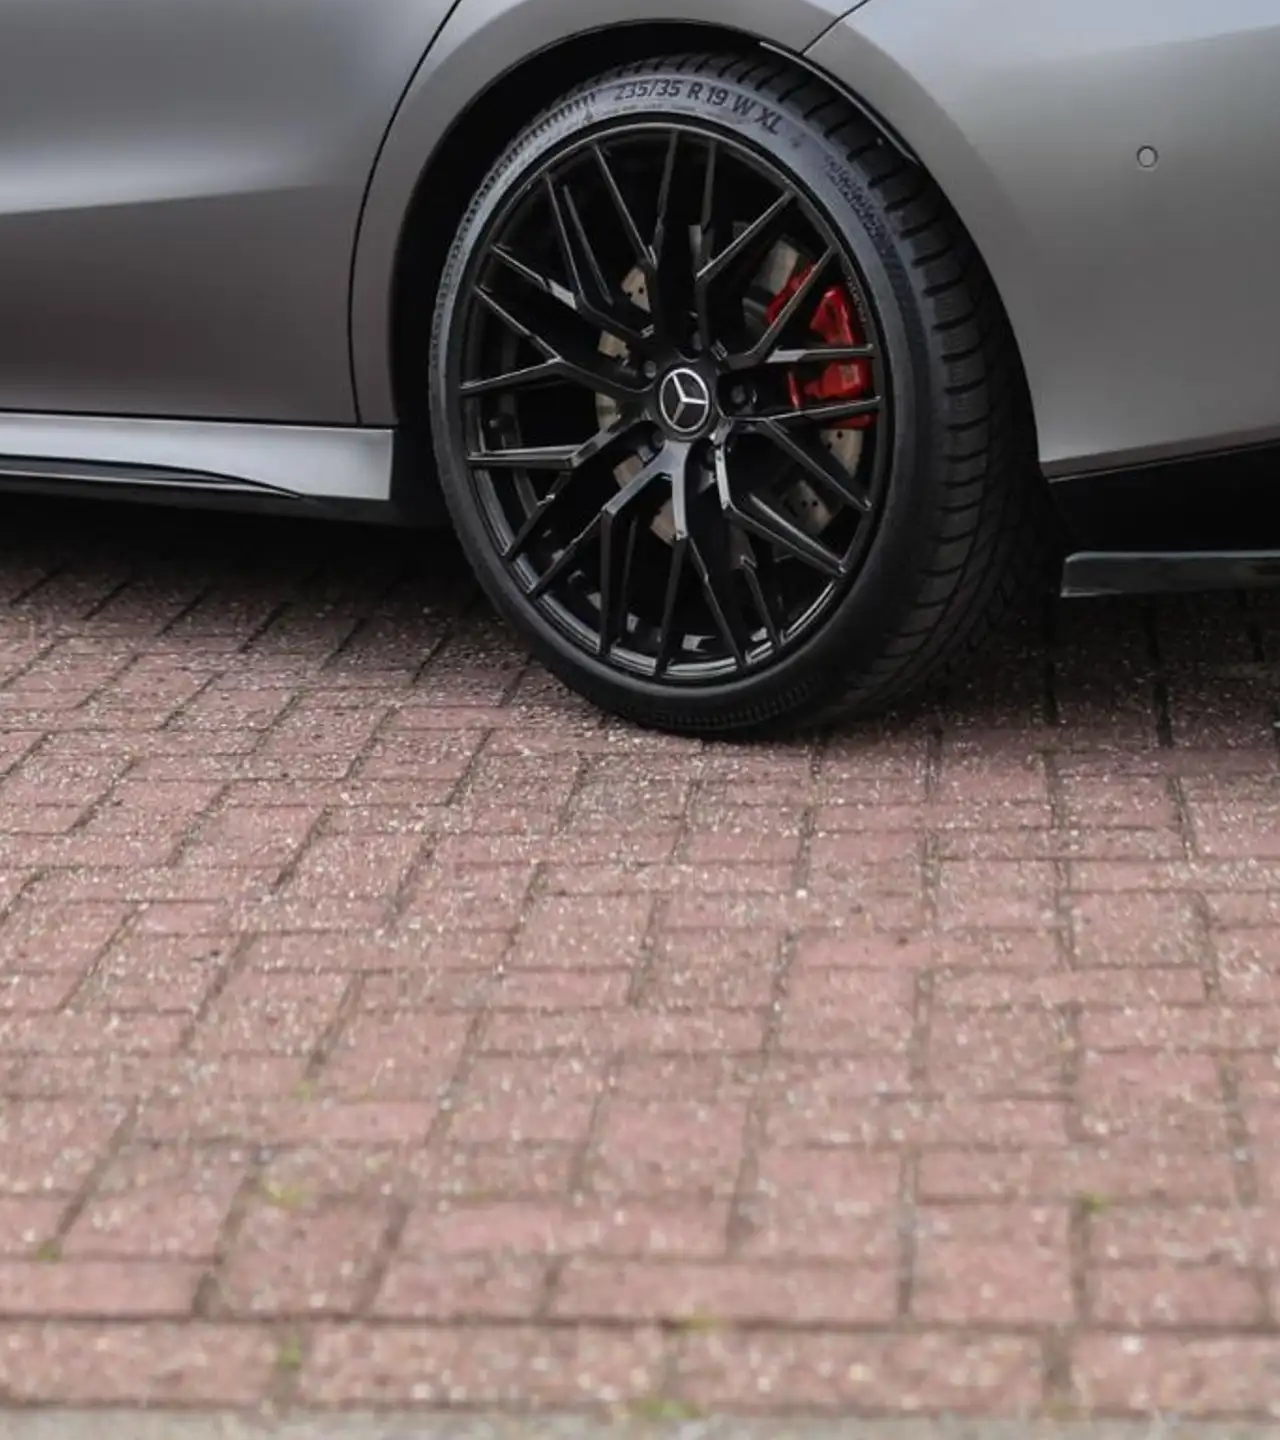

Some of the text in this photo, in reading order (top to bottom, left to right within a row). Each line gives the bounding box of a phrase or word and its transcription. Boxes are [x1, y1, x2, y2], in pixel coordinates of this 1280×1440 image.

[686, 81, 704, 101] R
[706, 86, 729, 107] 19
[753, 108, 784, 137] XL
